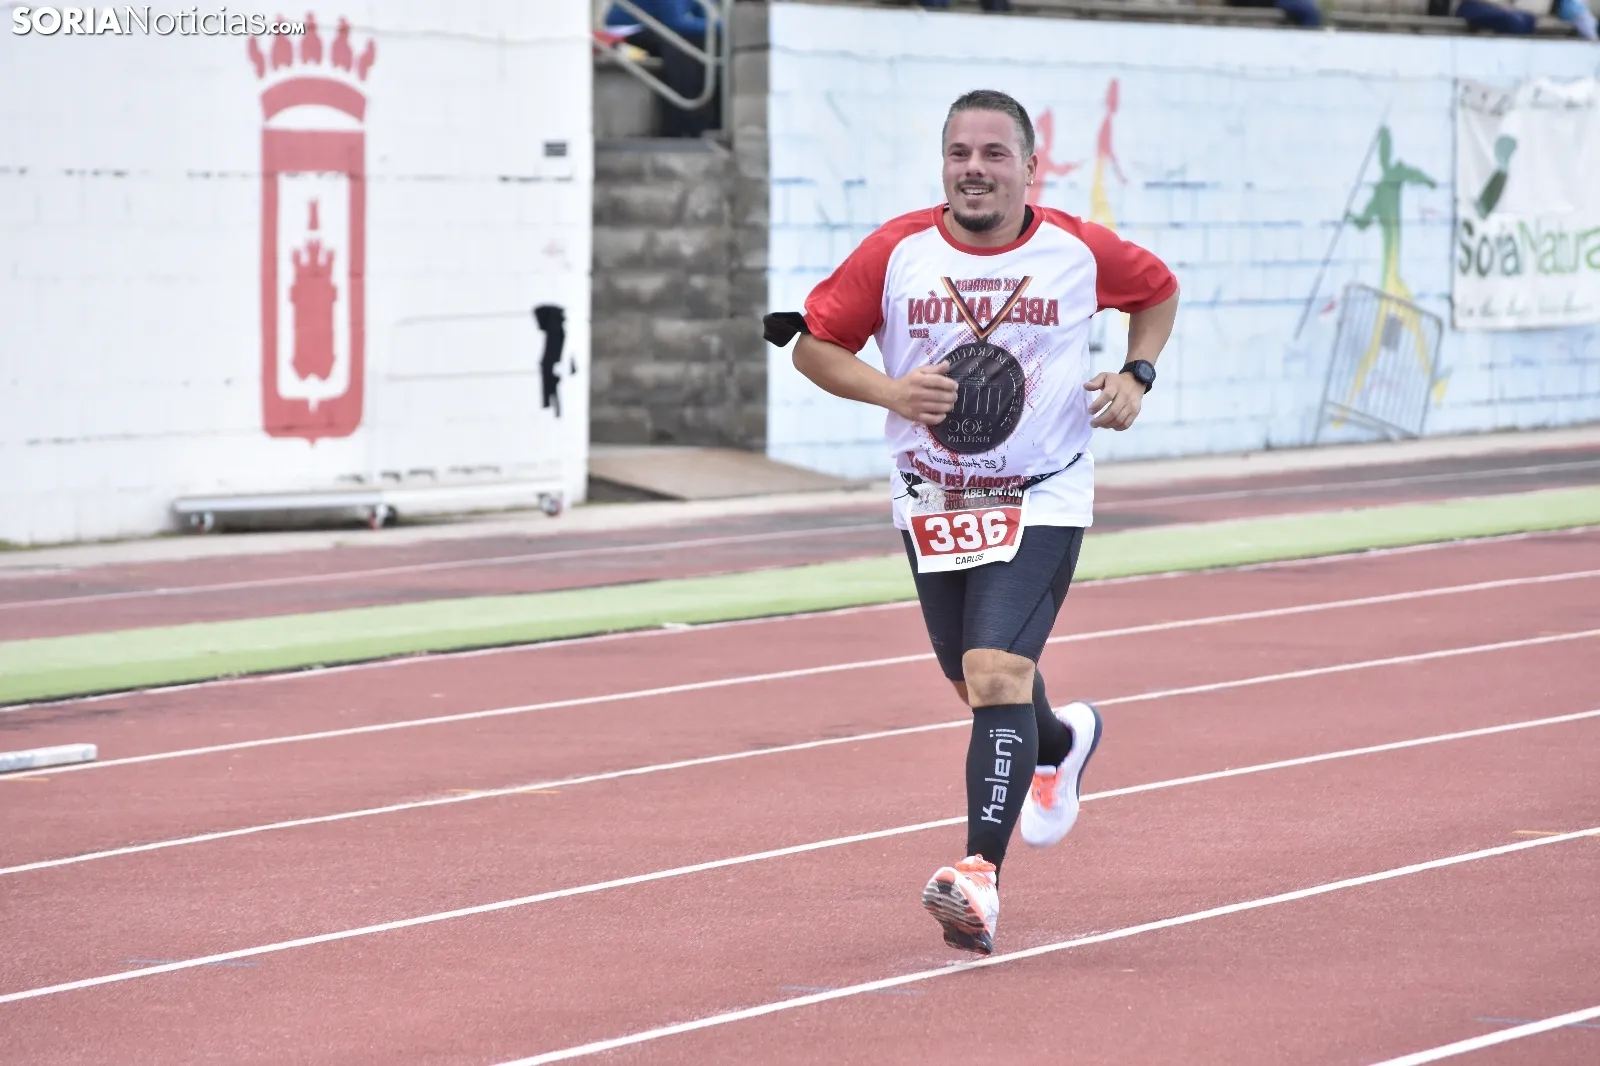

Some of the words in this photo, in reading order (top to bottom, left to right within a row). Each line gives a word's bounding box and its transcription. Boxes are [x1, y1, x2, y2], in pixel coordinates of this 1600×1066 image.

[964, 488, 987, 500] ABEL
[944, 499, 976, 511] CIUDAD
[980, 497, 990, 505] DE
[994, 496, 1021, 505] SORIA
[924, 511, 1008, 552] 336
[955, 553, 985, 565] CARLOS
[980, 728, 1023, 825] Kalenji
